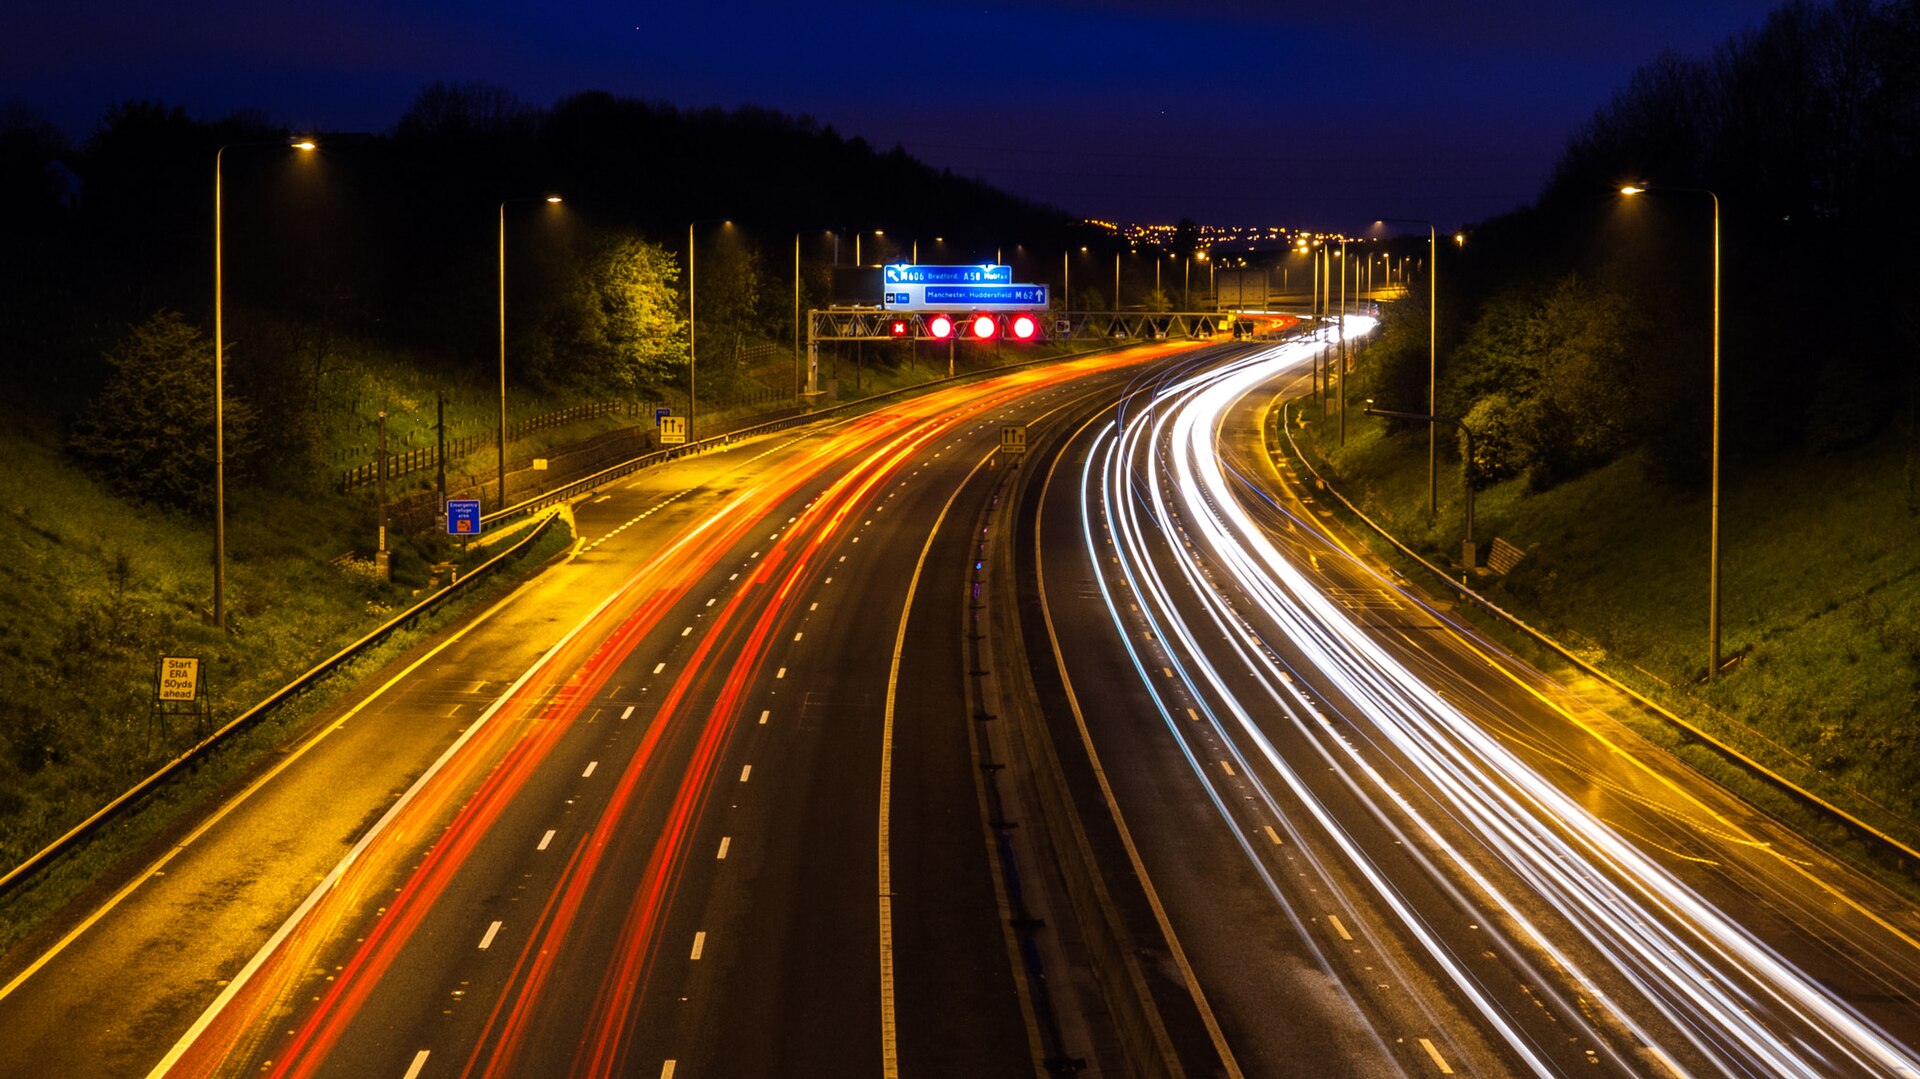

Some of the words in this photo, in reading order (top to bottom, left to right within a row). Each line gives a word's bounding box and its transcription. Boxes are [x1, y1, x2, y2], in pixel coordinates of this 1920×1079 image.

[900, 272, 924, 281] M606
[963, 272, 980, 281] A58
[1015, 291, 1033, 299] M62
[168, 660, 191, 668] Start
[169, 669, 188, 678] ERA
[164, 680, 192, 689] 50yds
